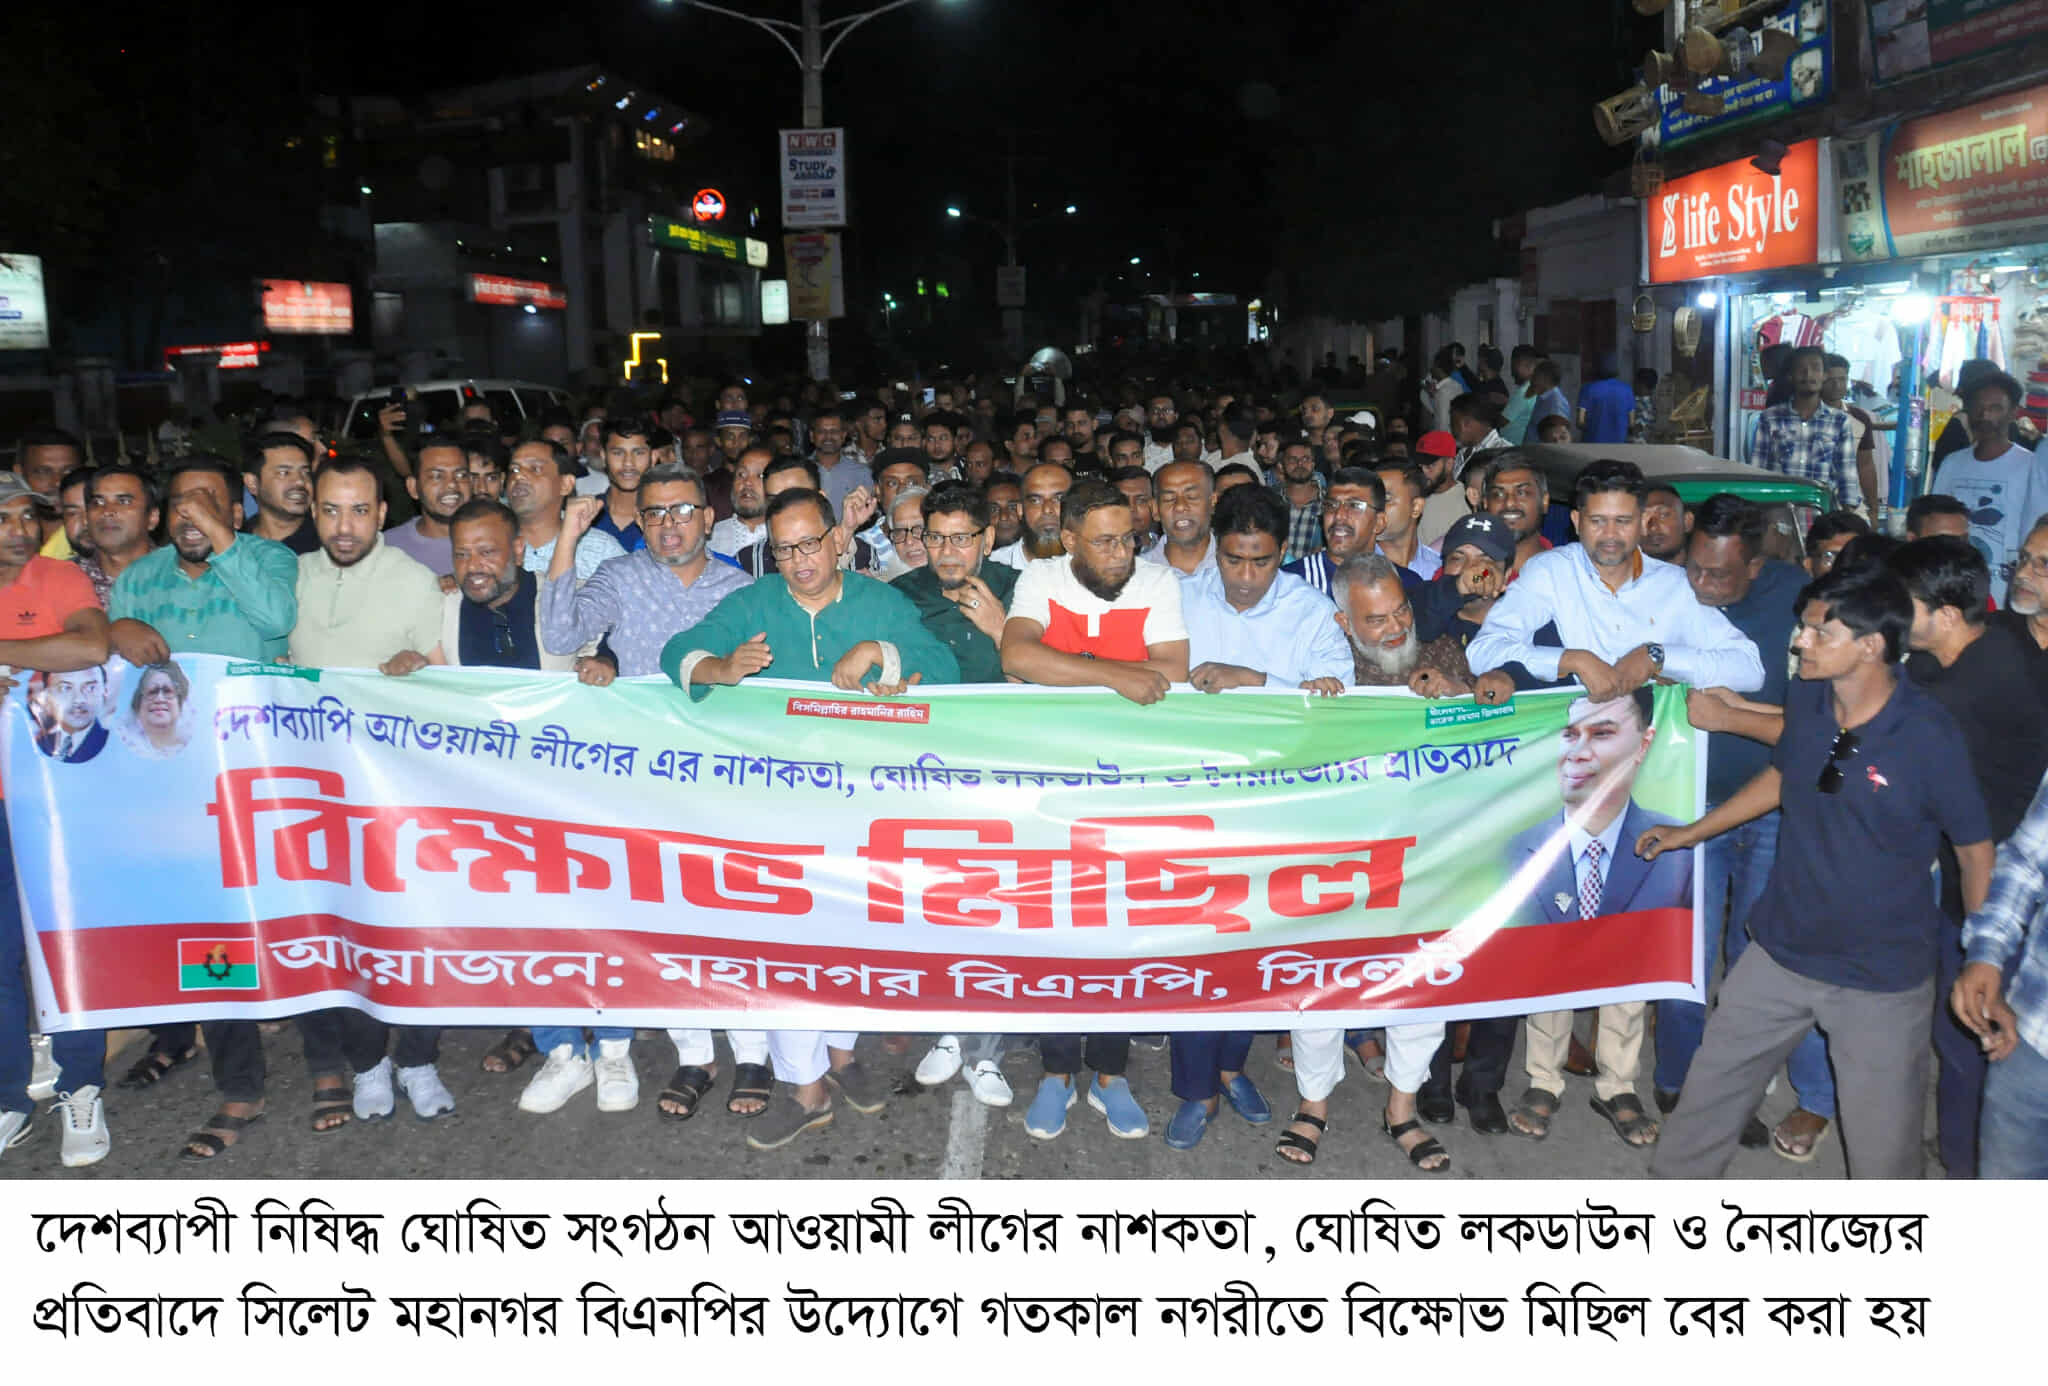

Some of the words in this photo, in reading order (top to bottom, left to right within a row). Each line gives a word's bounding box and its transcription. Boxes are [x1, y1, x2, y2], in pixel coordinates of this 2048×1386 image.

[1896, 124, 2028, 191] শাহজালাল
[1683, 191, 1721, 249] life
[1727, 175, 1800, 253] Style
[212, 695, 355, 745] দেশব্যাপি
[366, 710, 520, 761] আওয়ামী
[530, 724, 639, 777] লীগের
[649, 749, 704, 783] এর
[713, 752, 856, 798] নাশকতা,
[869, 752, 982, 793] ঘোষিত
[206, 766, 825, 917] বিক্ষোভ
[856, 814, 1417, 934] মিছিল
[268, 935, 625, 988] আয়োজনে:
[651, 953, 929, 998] মহানগর
[948, 959, 1229, 1001] বিএনপি,
[1257, 937, 1465, 992] সিলেট
